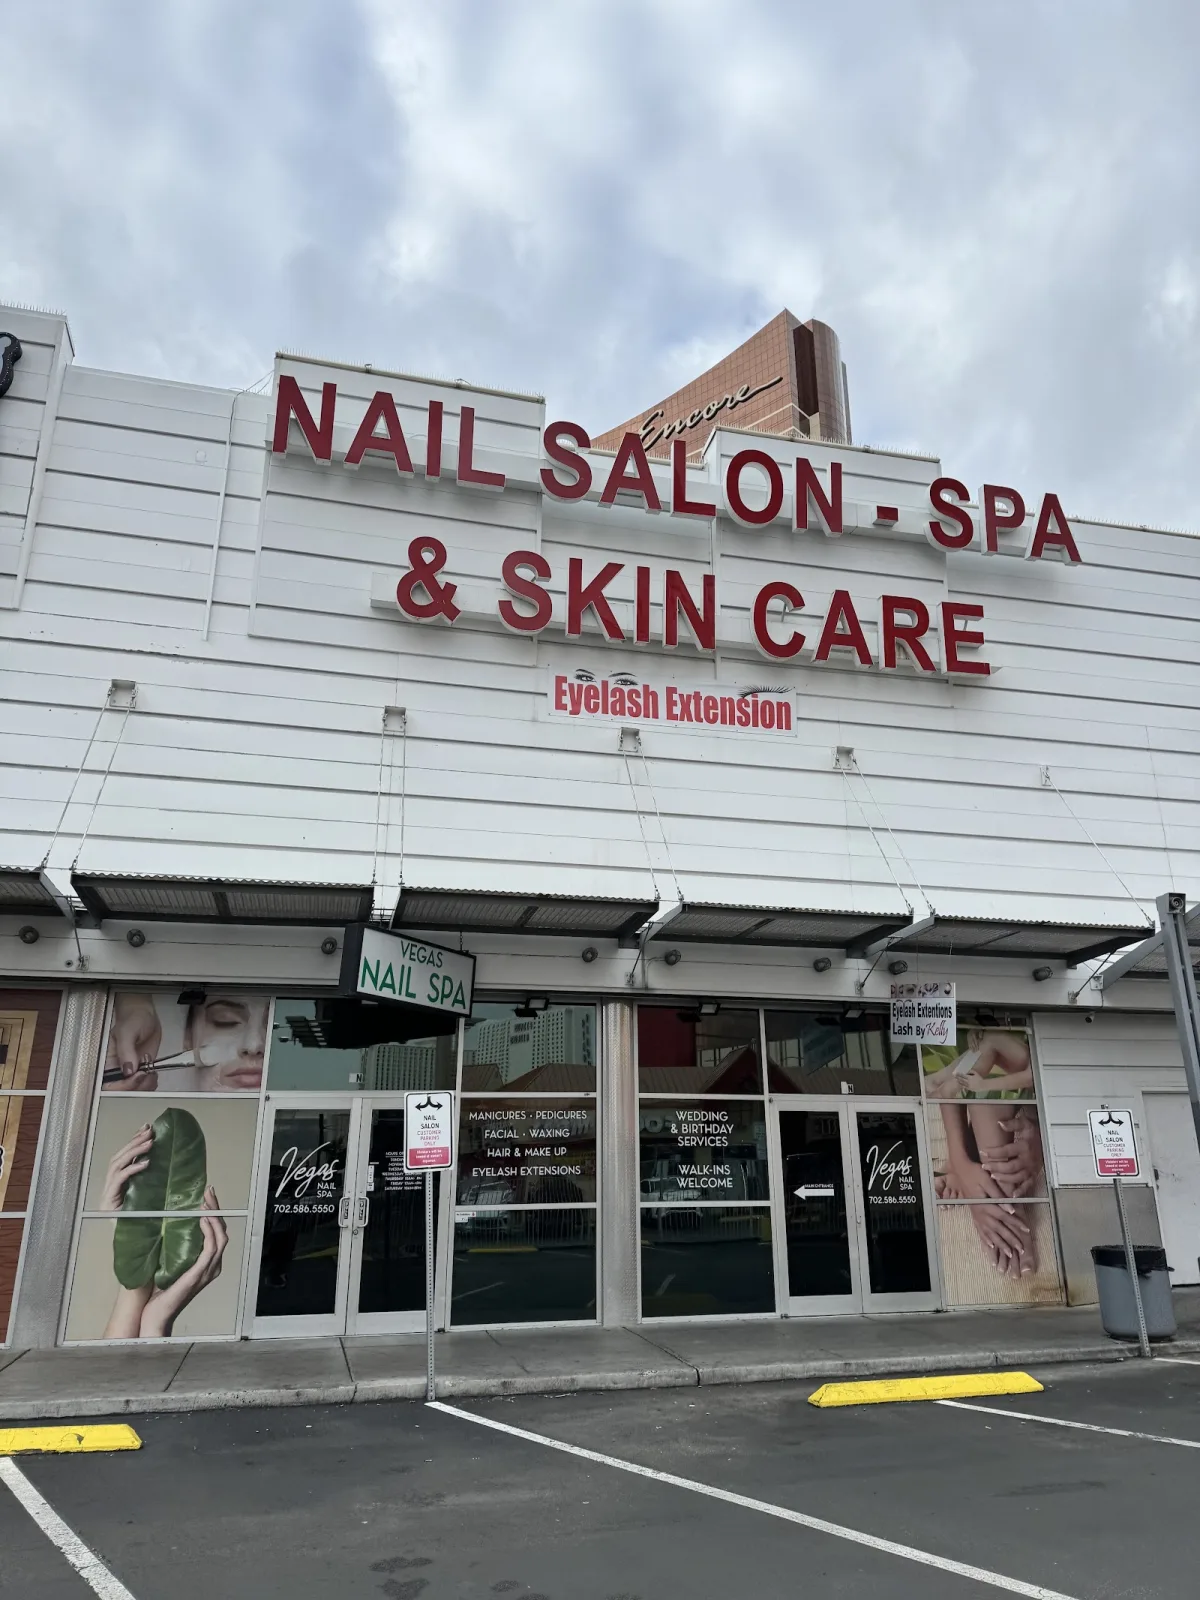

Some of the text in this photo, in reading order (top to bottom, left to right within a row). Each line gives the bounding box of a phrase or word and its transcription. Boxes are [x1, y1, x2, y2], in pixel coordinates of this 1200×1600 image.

[639, 376, 783, 452] Encore
[273, 376, 505, 487] NAIL
[540, 421, 843, 534] SALON
[928, 477, 1082, 564] SPA
[396, 536, 990, 675] & SKIN CARE
[555, 675, 792, 730] Eyelash Extension
[401, 940, 443, 968] VEGAS
[361, 956, 466, 1009] NAIL SPA
[892, 1002, 952, 1021] Eyelash Extentions
[893, 1019, 948, 1044] Lash By Kelly
[469, 1110, 587, 1120] MANICURES PEDICURES
[676, 1111, 728, 1122] WEDDING
[484, 1128, 570, 1139] FACIAL WAXING
[670, 1124, 734, 1134] & BIRTHDAY
[677, 1136, 728, 1147] SERVICES
[487, 1147, 567, 1157] HAIR & MAKE UP
[275, 1141, 339, 1198] Vegas
[472, 1165, 581, 1177] EYELASH EXTENSIONS
[678, 1164, 731, 1175] WALK-INS
[866, 1140, 912, 1191] Vegas
[317, 1182, 336, 1190] NAIL
[677, 1177, 733, 1188] WELCOME
[900, 1183, 913, 1191] SPA
[317, 1190, 333, 1198] SPA
[869, 1195, 916, 1204] 702.586.5550
[274, 1204, 335, 1213] 702.586.5550
